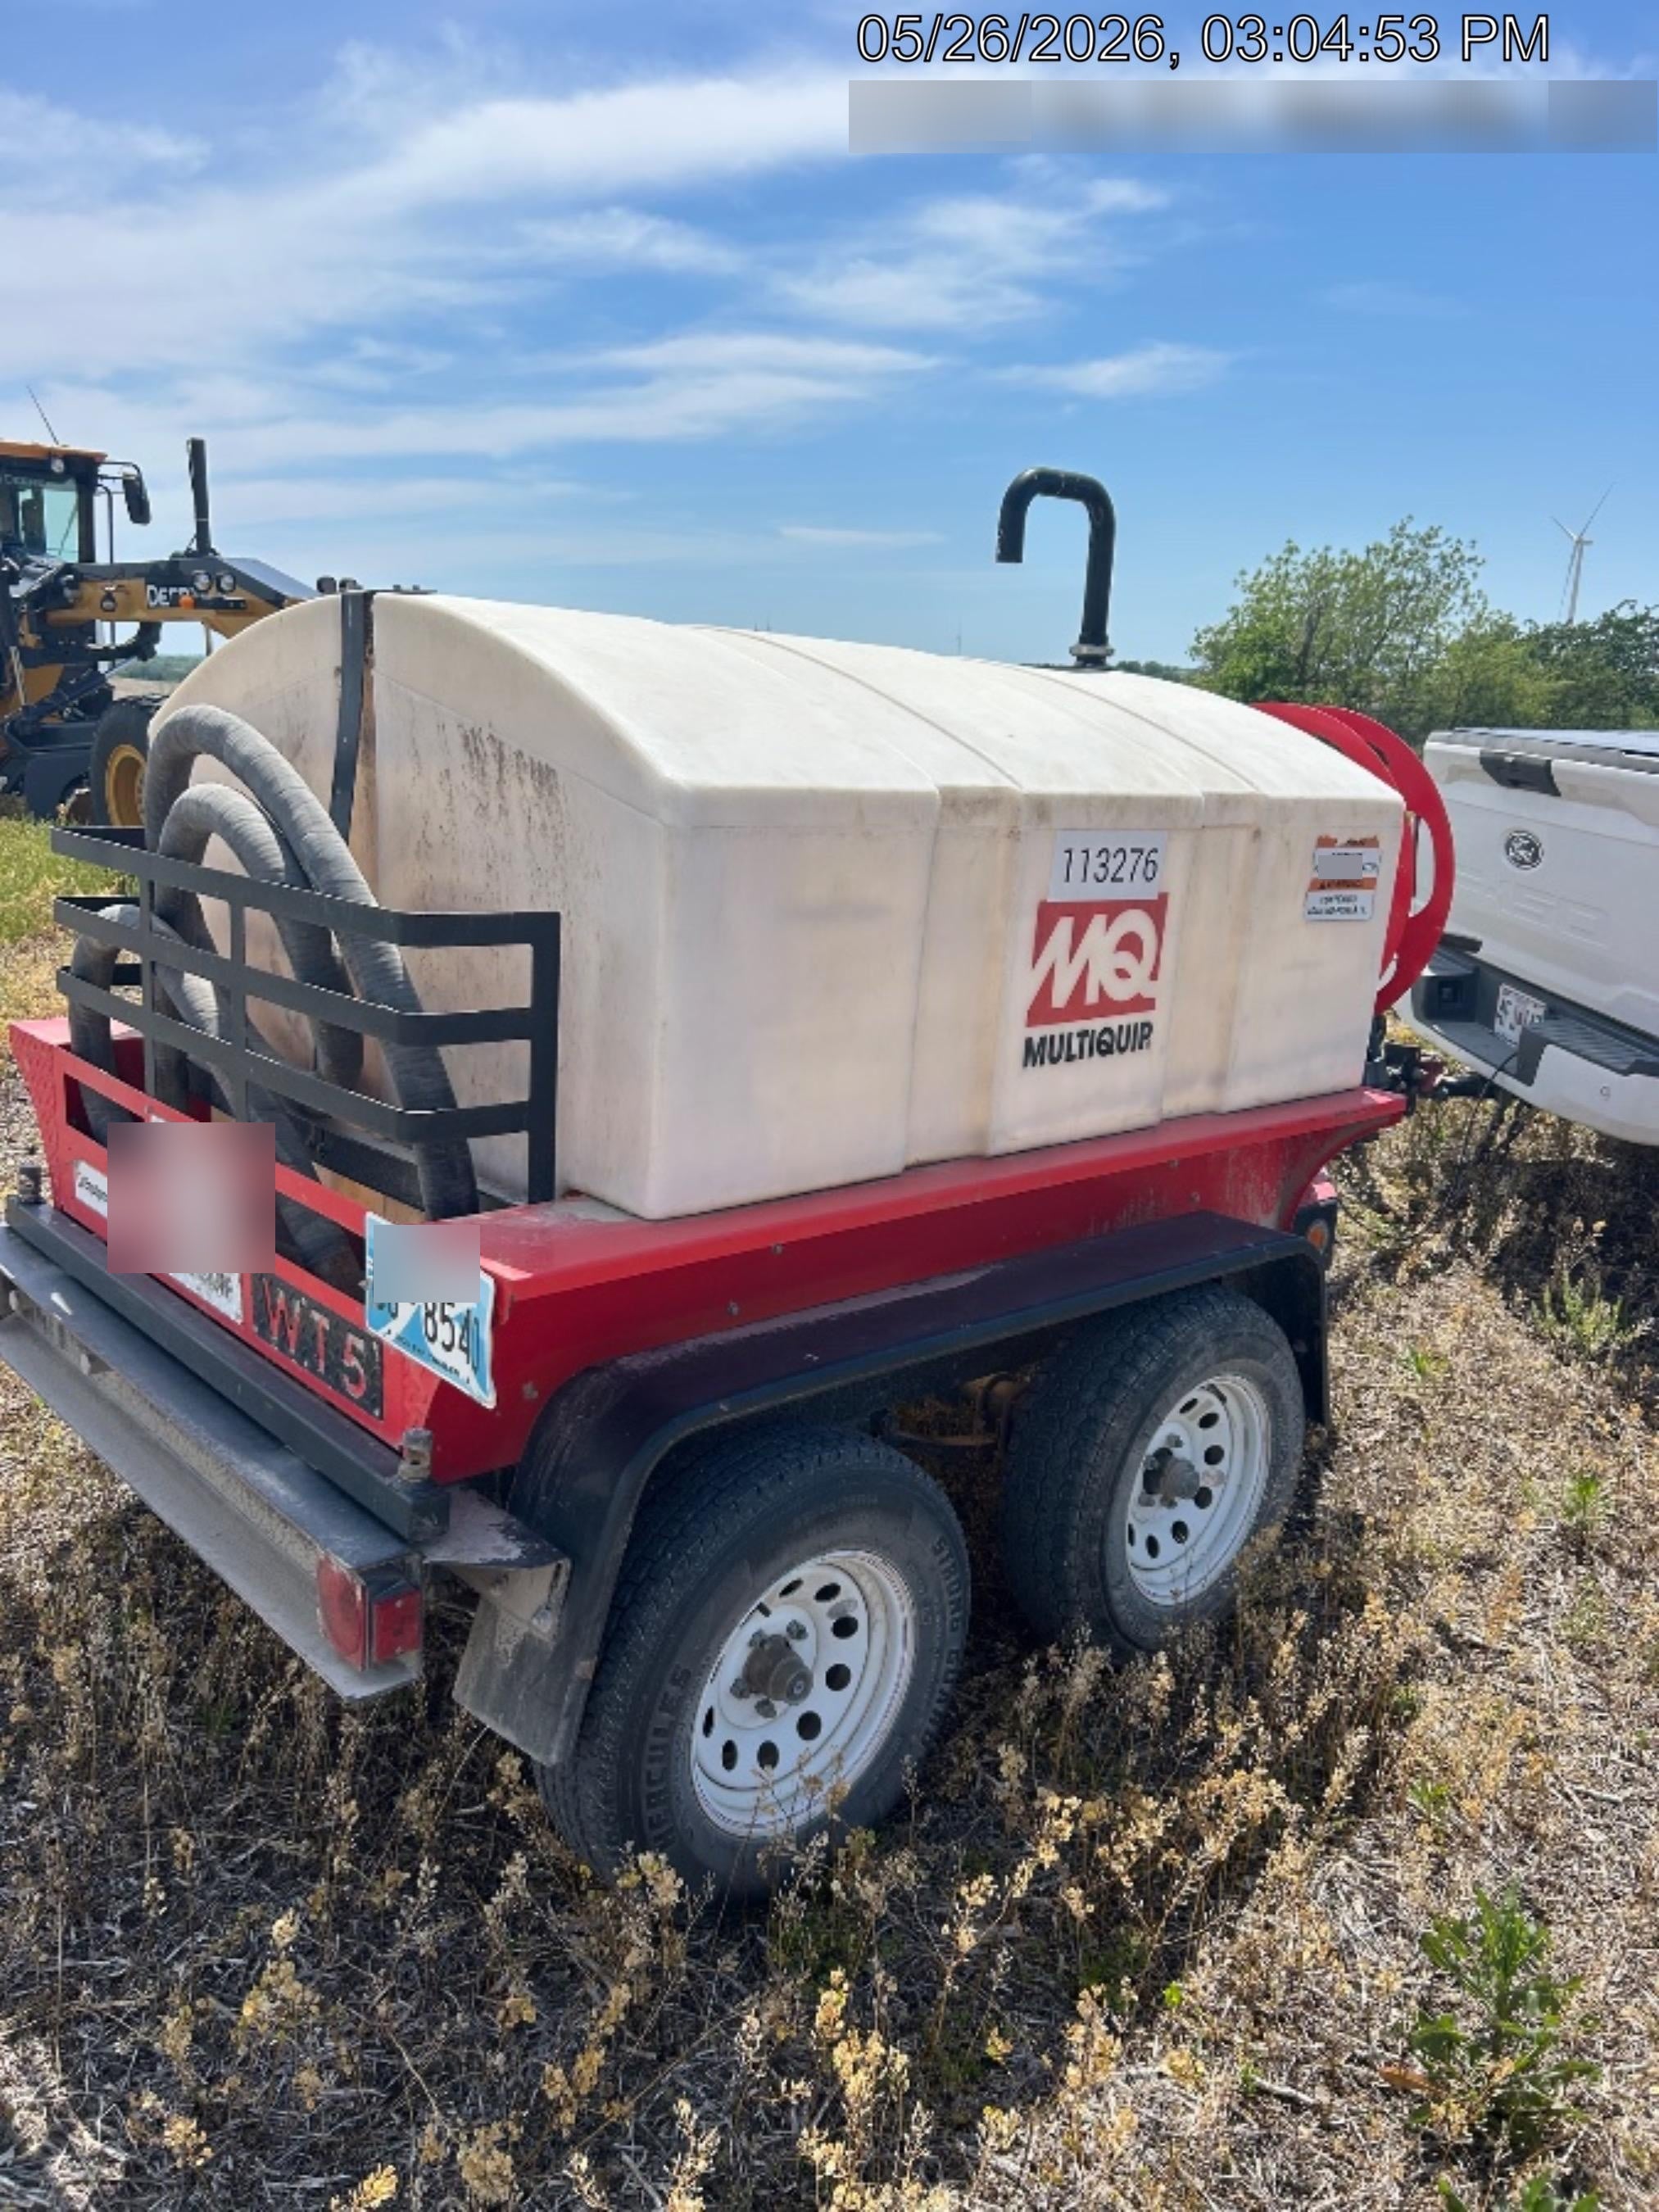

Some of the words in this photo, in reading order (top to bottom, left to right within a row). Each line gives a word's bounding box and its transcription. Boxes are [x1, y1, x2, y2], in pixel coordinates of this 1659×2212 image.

[1063, 847, 1158, 883] 113276
[1025, 908, 1158, 1009] MQ
[1022, 1022, 1154, 1068] MULTIQUIP
